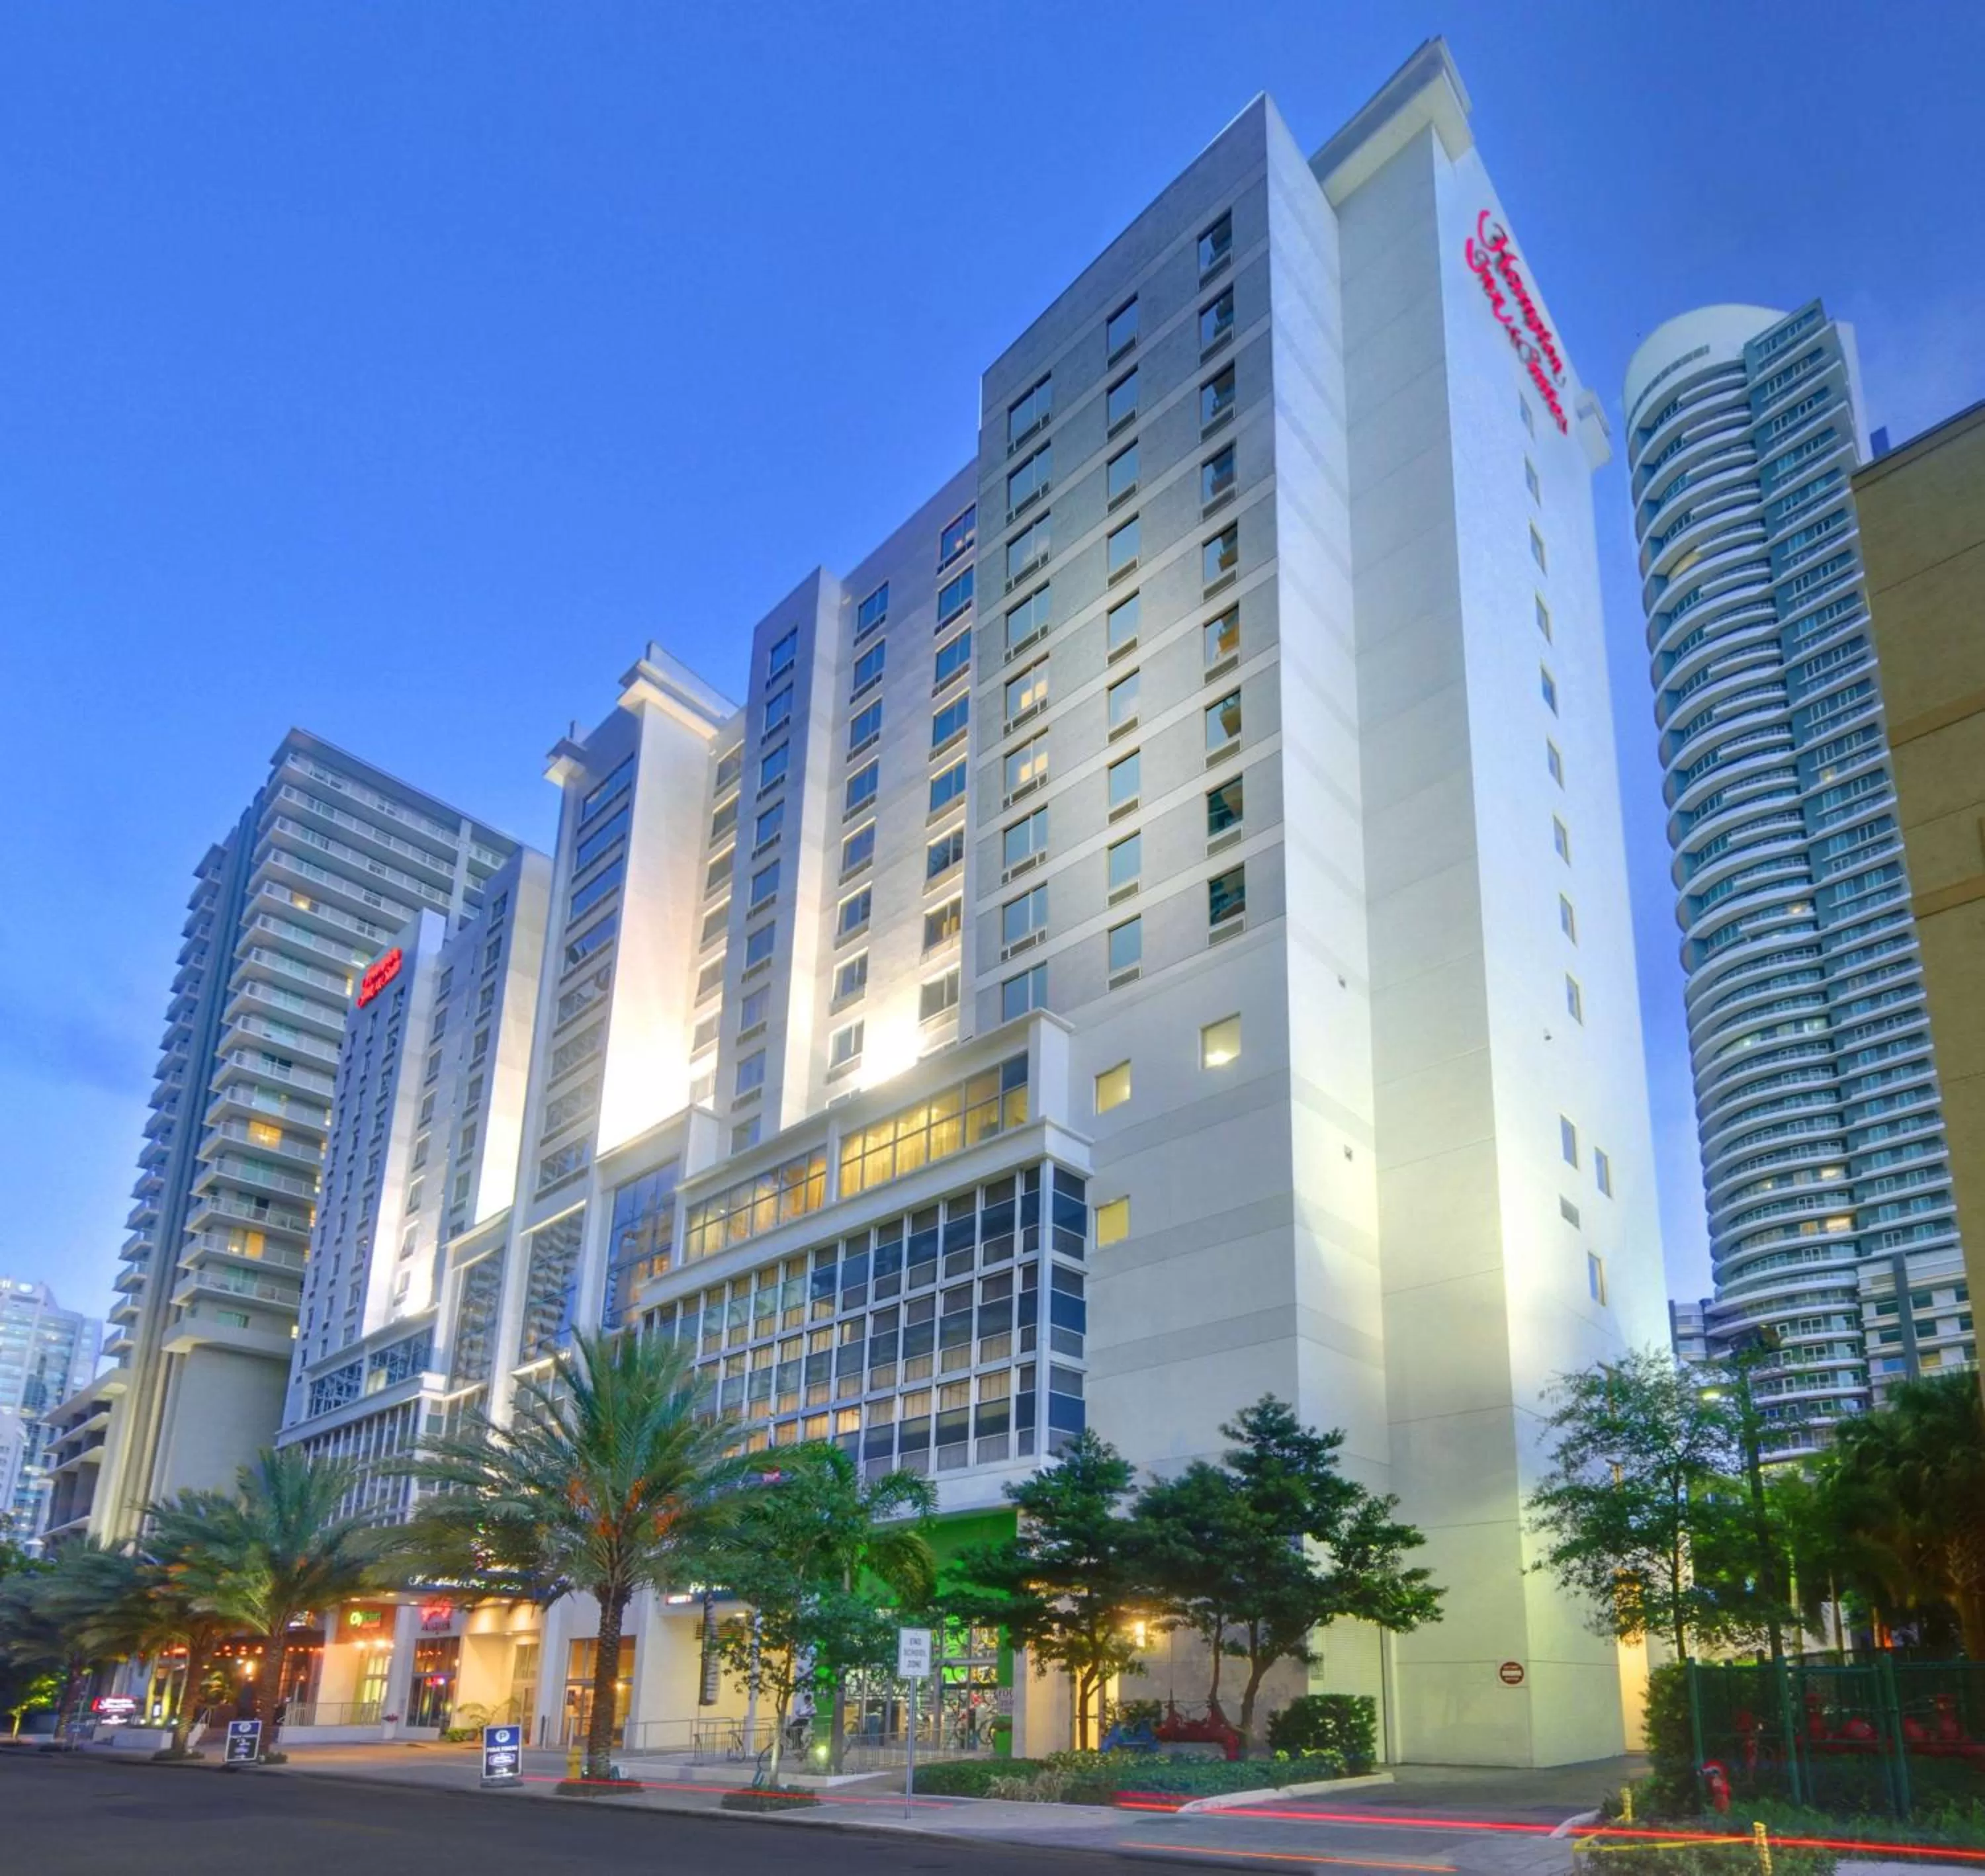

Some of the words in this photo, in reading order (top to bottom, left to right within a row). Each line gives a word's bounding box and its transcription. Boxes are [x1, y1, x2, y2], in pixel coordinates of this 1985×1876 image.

[1476, 210, 1566, 388] Hampton
[1464, 237, 1513, 323] Inn
[1517, 341, 1568, 436] Suites
[910, 1637, 922, 1646] END
[903, 1648, 926, 1657] SCHOOL
[907, 1660, 922, 1668] ZONE
